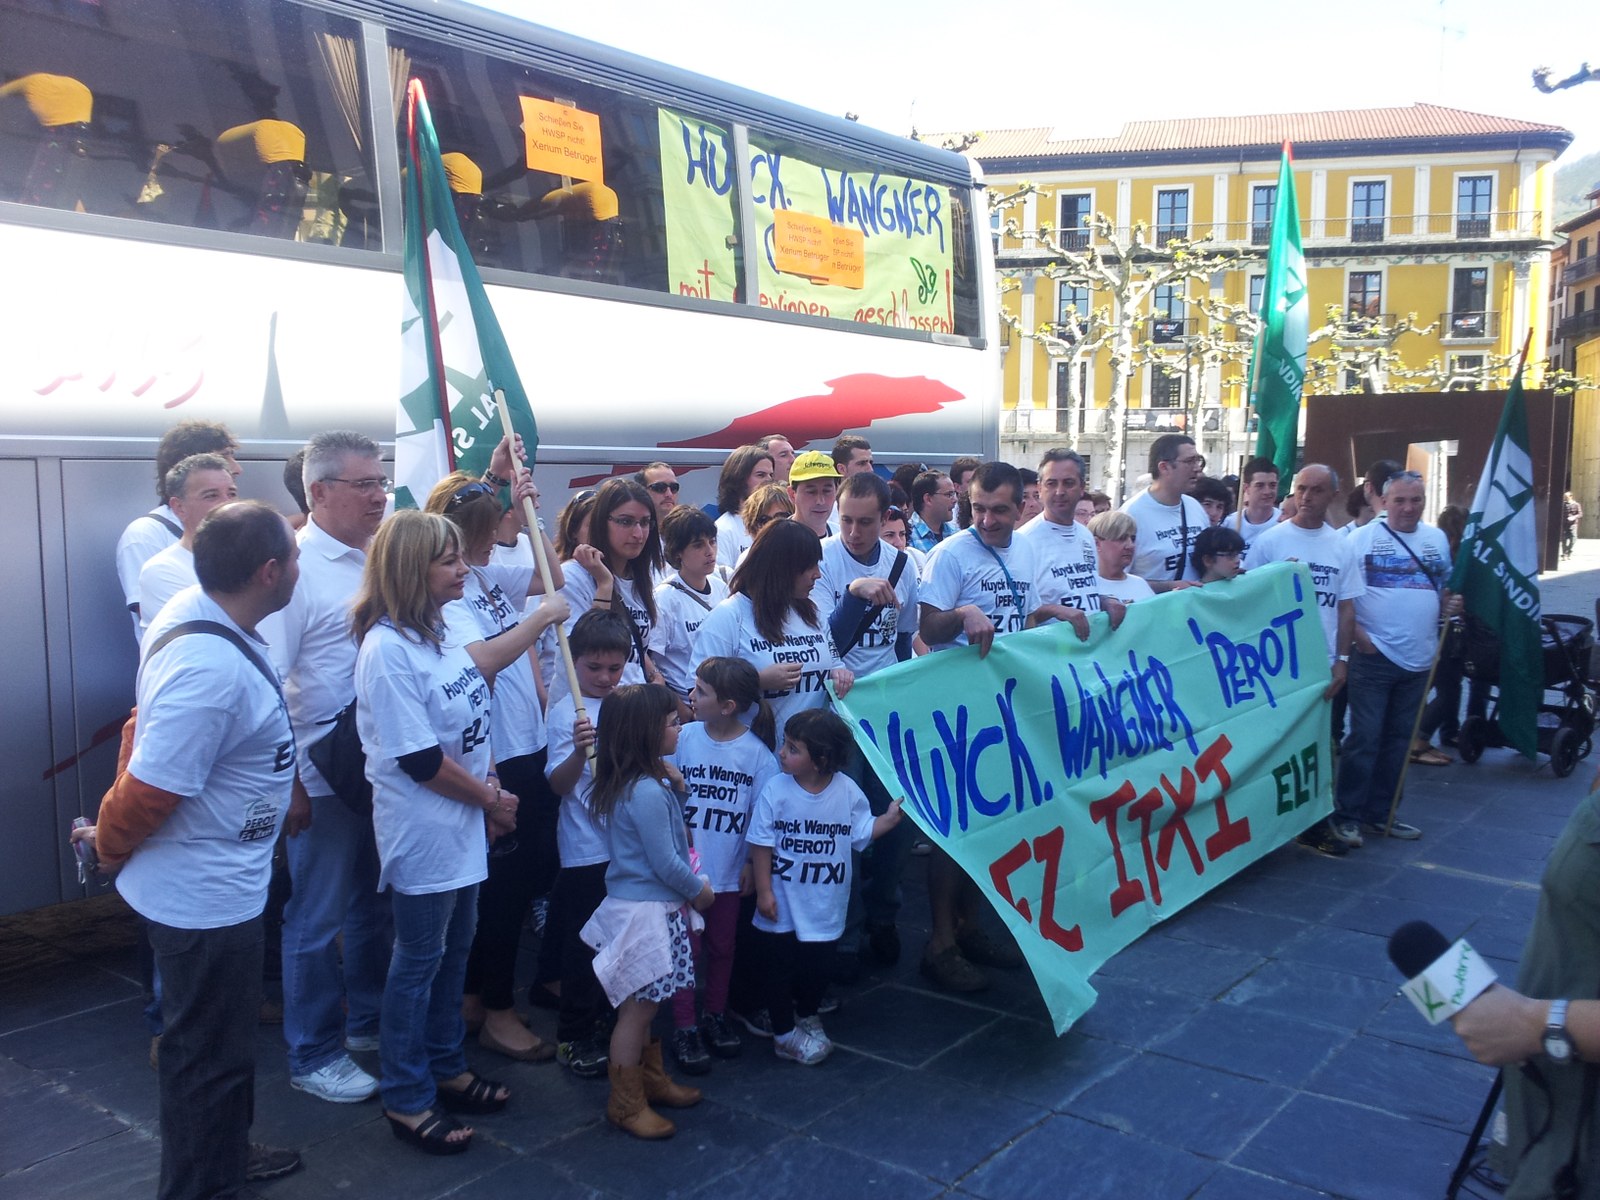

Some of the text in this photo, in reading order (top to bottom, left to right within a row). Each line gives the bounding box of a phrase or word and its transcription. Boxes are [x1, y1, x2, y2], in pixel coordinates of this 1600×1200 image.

[822, 168, 945, 253] WANGNER
[679, 259, 716, 300] mit
[773, 646, 820, 664] (PEROT)
[1051, 649, 1199, 780] WANGNER
[689, 783, 738, 804] PEROT)
[702, 807, 747, 835] ITXI
[804, 819, 852, 839] Wangner
[780, 834, 836, 856] (PEROT)
[988, 733, 1320, 952] EZ ITXI ELA
[799, 861, 846, 885] ITXI
